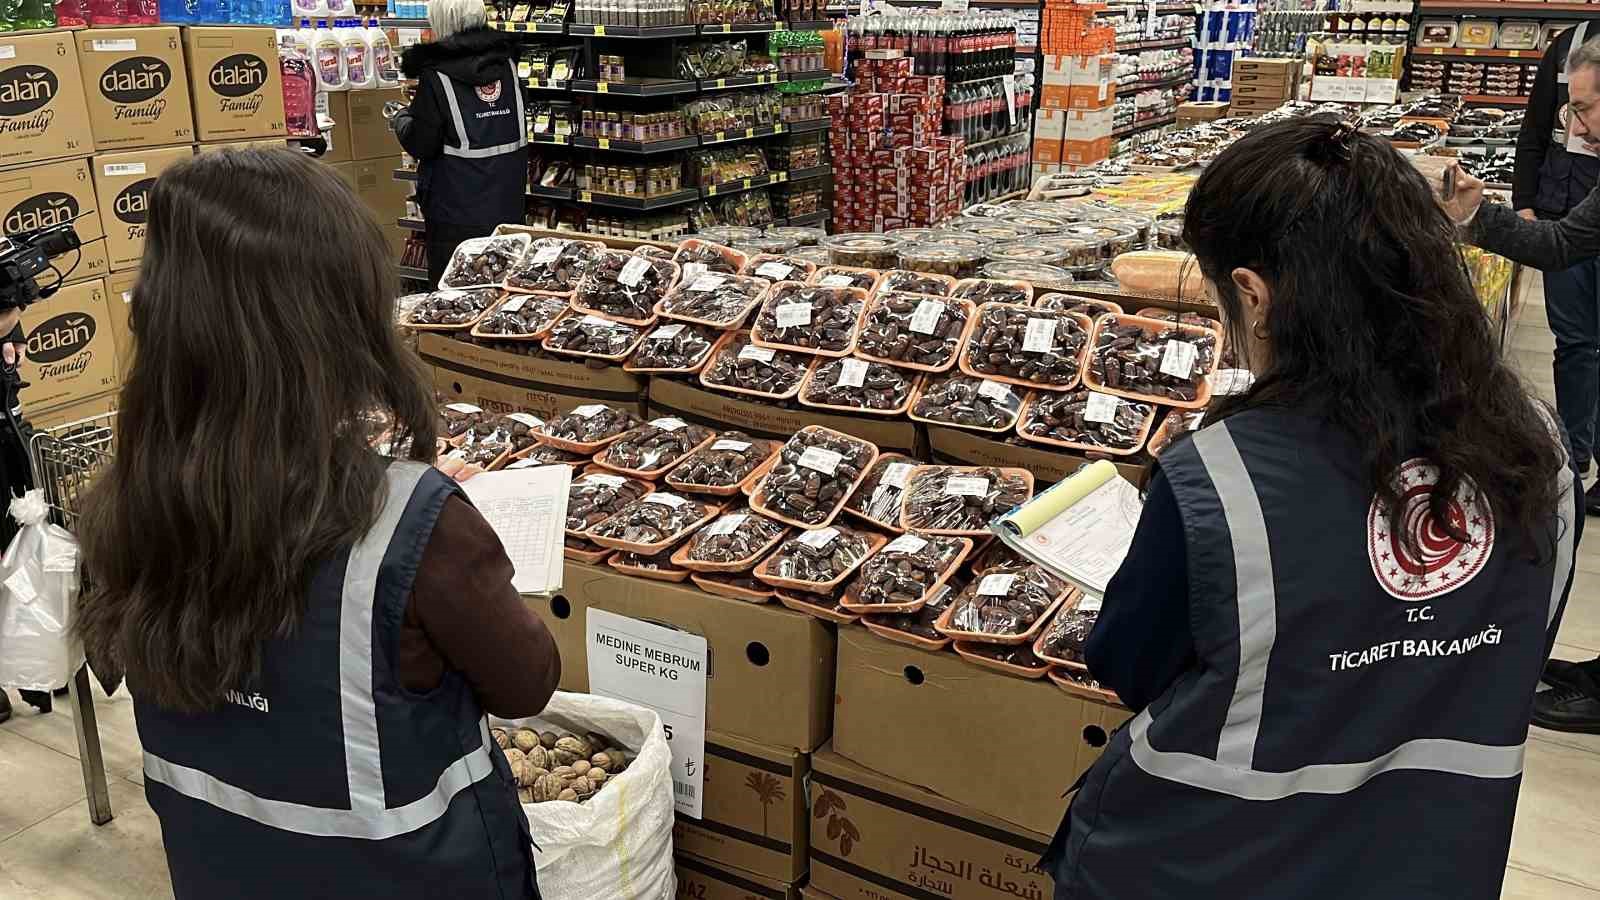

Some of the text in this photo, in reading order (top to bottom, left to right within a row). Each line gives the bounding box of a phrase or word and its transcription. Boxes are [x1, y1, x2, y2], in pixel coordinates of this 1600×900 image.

[102, 69, 164, 92] dalan
[211, 65, 262, 86] dalan
[0, 79, 51, 103] alan
[114, 99, 166, 120] Family
[220, 95, 263, 114] Family
[0, 110, 53, 133] Family
[116, 193, 149, 214] dal
[27, 323, 90, 355] dalan
[39, 351, 91, 381] Family
[1406, 606, 1434, 622] T.C.
[596, 633, 701, 672] MEDINE MEBRUM
[1329, 623, 1502, 671] TİCARET BAKANLIĞI
[615, 654, 678, 681] SUPER KG
[225, 688, 269, 713] NLIĞI
[910, 845, 972, 881] الحجاز
